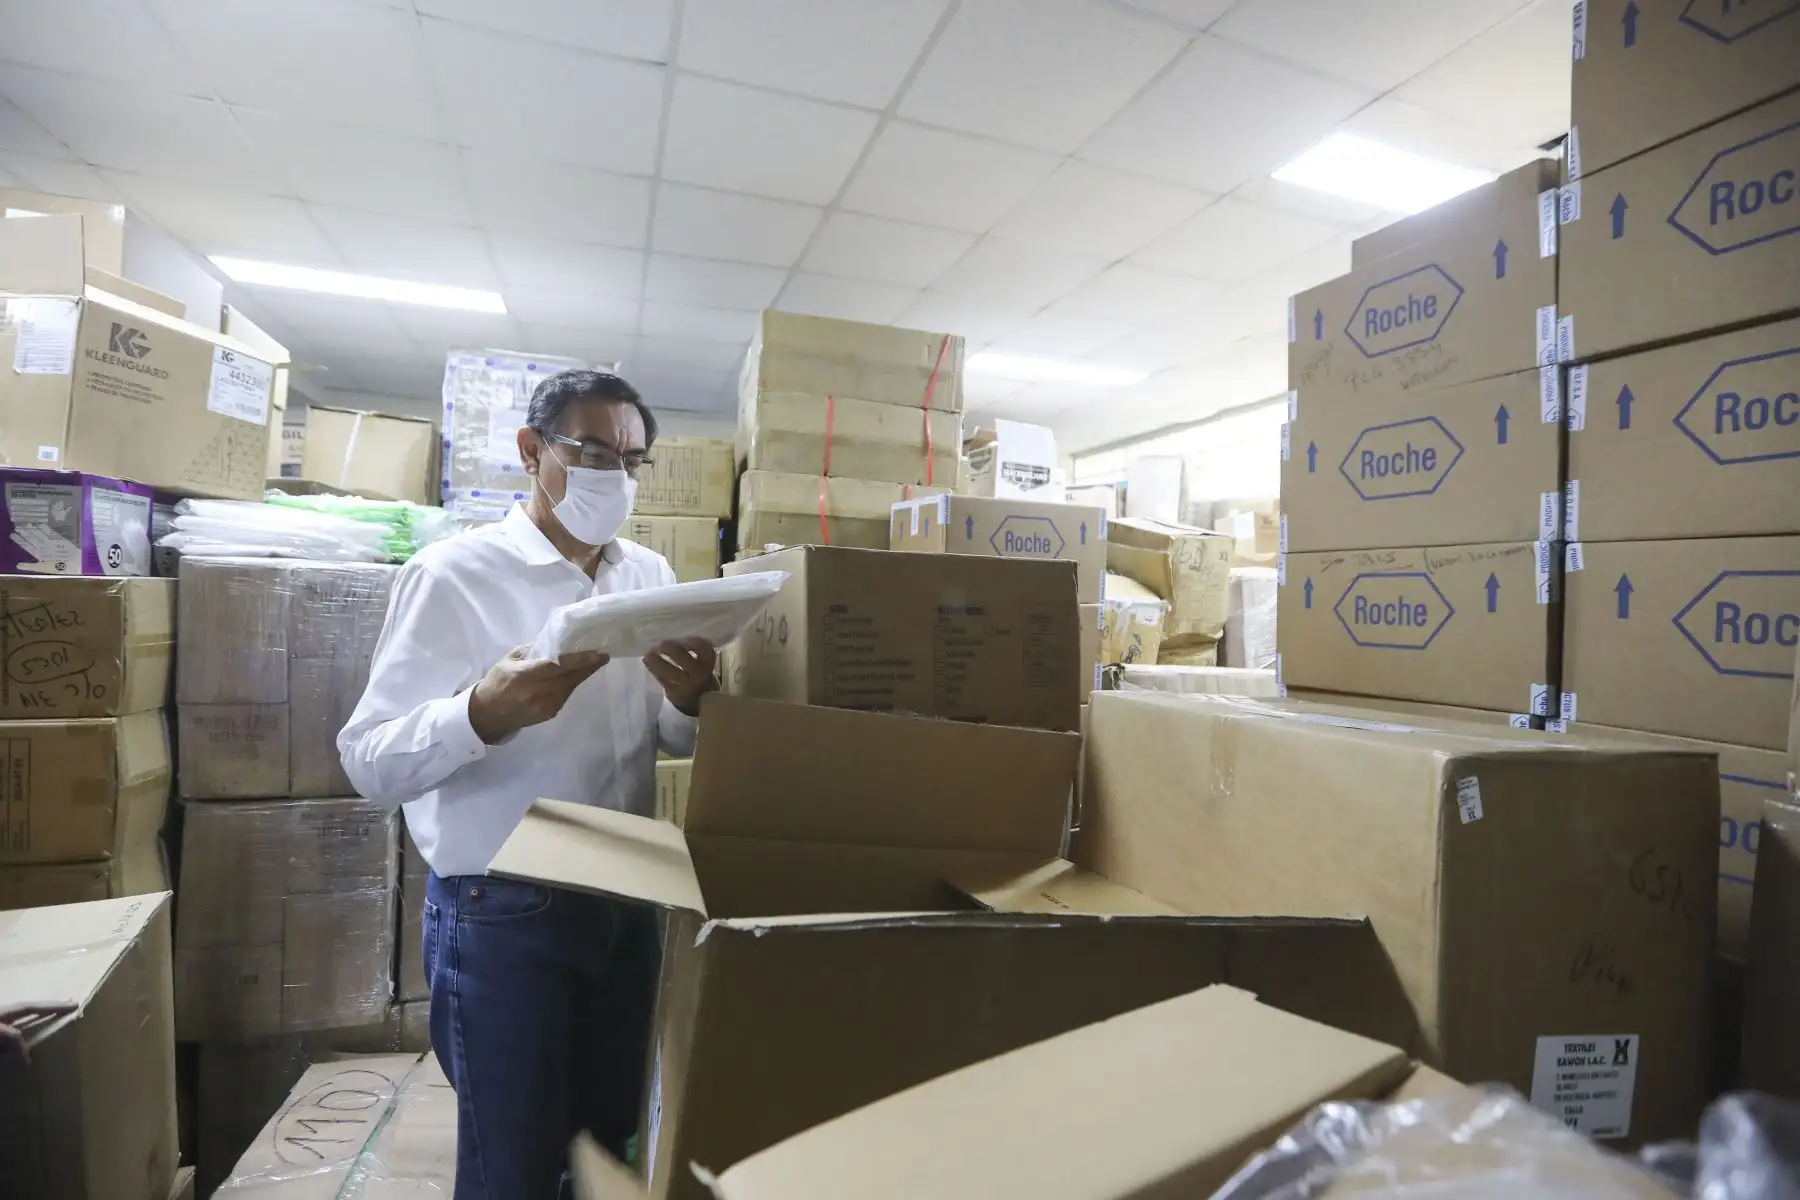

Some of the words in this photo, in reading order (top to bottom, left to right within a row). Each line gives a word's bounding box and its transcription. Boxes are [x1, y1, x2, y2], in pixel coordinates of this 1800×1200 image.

[1710, 169, 1800, 226] Roc
[1365, 292, 1437, 338] Roche
[84, 347, 170, 380] KLEENGUARD
[1715, 392, 1800, 434] Roc
[1361, 442, 1437, 480] Roche
[109, 549, 122, 562] 50
[1005, 530, 1051, 554] Roche
[1355, 595, 1428, 628] Roche
[1715, 601, 1800, 646] Roc
